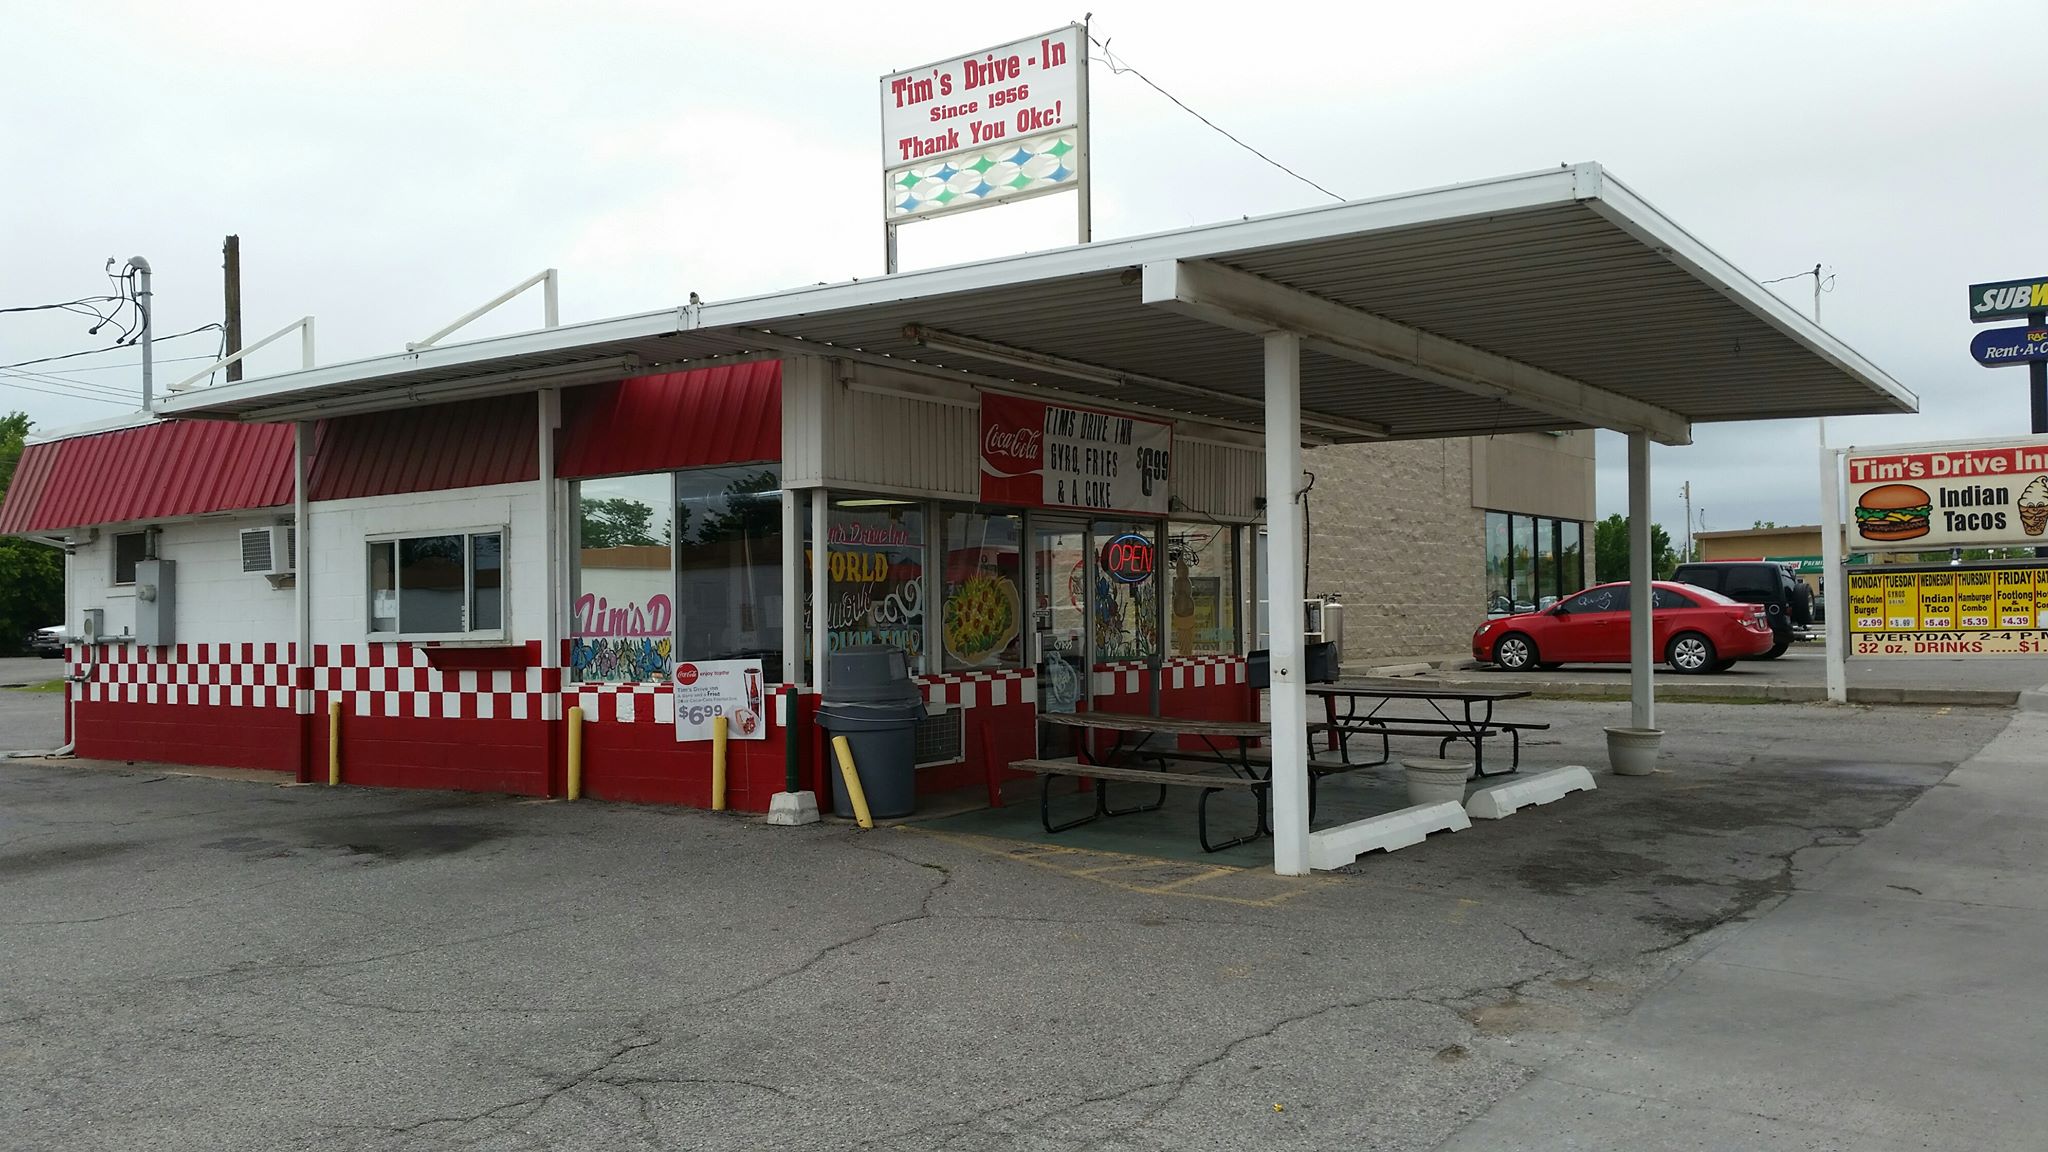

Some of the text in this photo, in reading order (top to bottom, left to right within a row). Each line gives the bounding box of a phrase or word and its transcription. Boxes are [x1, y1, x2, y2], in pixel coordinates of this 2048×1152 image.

[892, 69, 952, 108] Tim's
[963, 54, 1020, 90] Drive
[1041, 39, 1067, 70] In
[930, 84, 1029, 121] Since 1956
[899, 100, 1062, 160] Thank You Okc!
[1046, 407, 1133, 446] TIMS DRIVE INN
[985, 424, 1041, 460] Coca-Cola
[1051, 443, 1118, 478] GYRO, FRIES
[1851, 457, 1926, 481] Tim's
[1931, 454, 2008, 477] Drive
[1057, 479, 1112, 509] & A COKE
[1939, 485, 2009, 508] Indian
[1943, 510, 2007, 532] Tacos
[1108, 543, 1154, 572] OPEN
[1851, 576, 1883, 589] MONDAY
[1885, 574, 1917, 588] TUESDAY
[1920, 573, 1954, 587] WEDNESDAY
[1958, 572, 1991, 585] THURSDAY
[1997, 571, 2033, 585] FRIDAY
[1850, 594, 1883, 604] Fried Onion
[1887, 590, 1906, 598] GYROS
[1921, 594, 1954, 603] Indian
[1958, 592, 1993, 604] Hamburger
[1997, 590, 2033, 602] Footlong
[1854, 605, 1879, 616] Burger
[1924, 604, 1950, 613] Taco
[1961, 604, 1988, 612] Combo
[1858, 618, 1883, 627] $2.99
[1925, 618, 1950, 627] $5.49
[1962, 617, 1988, 626] $5.39
[2002, 616, 2029, 625] $4.39
[1863, 632, 1966, 642] EVERYDAY
[1980, 631, 2012, 641] 2-4
[1858, 642, 1879, 654] 32
[1884, 643, 1908, 654] oz.
[1914, 641, 1983, 654] DRINKS
